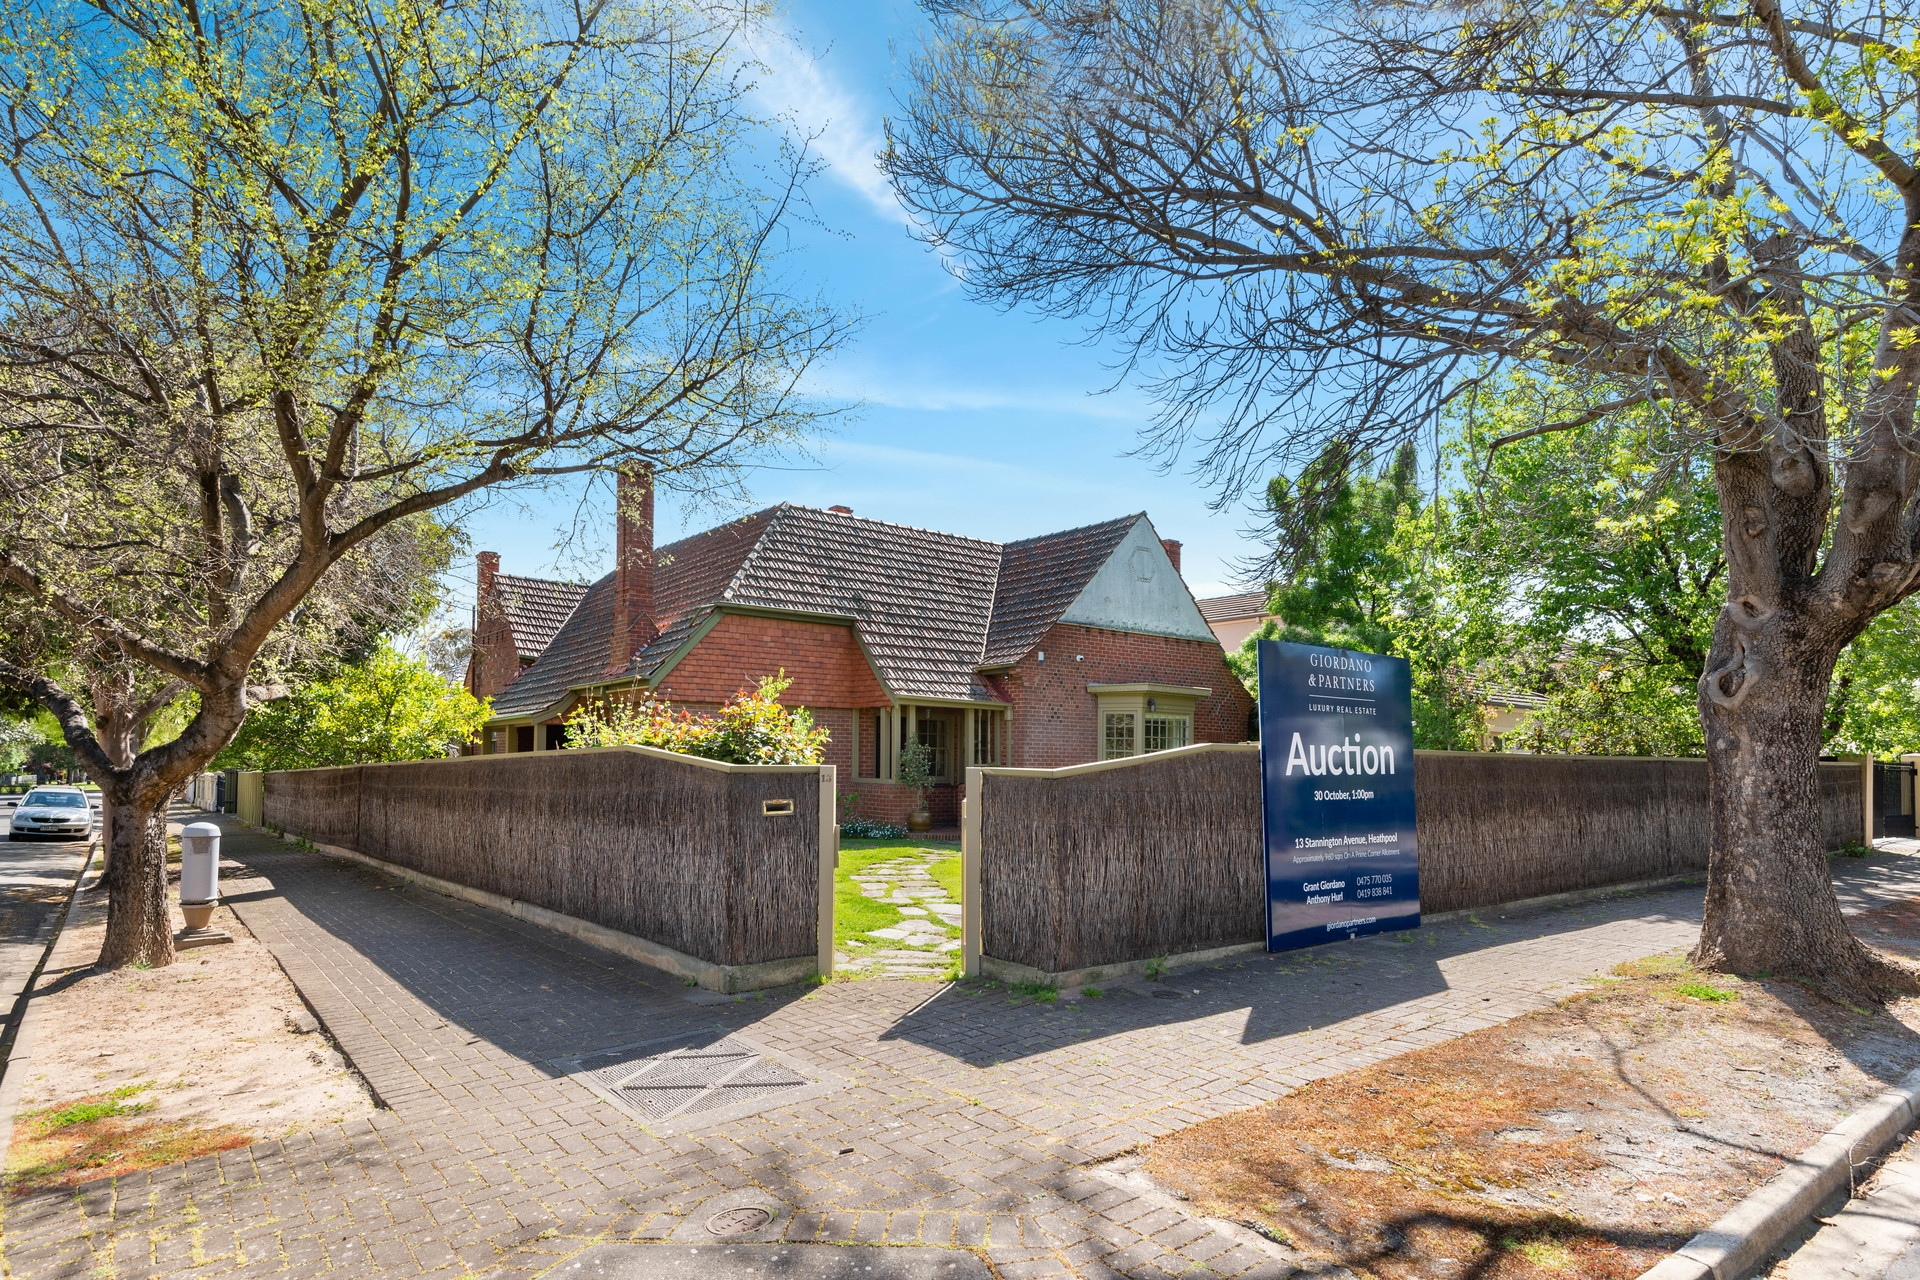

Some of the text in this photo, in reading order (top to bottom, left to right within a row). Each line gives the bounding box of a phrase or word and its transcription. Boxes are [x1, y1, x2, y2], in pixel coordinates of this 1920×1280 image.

[1310, 653, 1372, 673] GIORDANO
[1318, 674, 1375, 692] PARTNERS
[1309, 703, 1376, 715] LUXURY REAL ESTATE
[1285, 732, 1395, 776] Auction
[821, 774, 832, 783] 13
[1314, 789, 1374, 801] 30 October, 1:00pm
[1295, 832, 1397, 849] 13 Stannington Avenue, Heathpool
[1293, 852, 1324, 864] Approximately
[1355, 850, 1367, 858] Prime
[1367, 849, 1381, 857] Corner
[1381, 848, 1400, 856] Allotment
[1303, 879, 1345, 892] Grant Giordano
[1356, 873, 1392, 886] 0475 770 035
[1306, 891, 1343, 905] Anthony Hurl
[1356, 886, 1393, 898] 0419 838 841
[1326, 916, 1376, 931] giordanopartners.com
